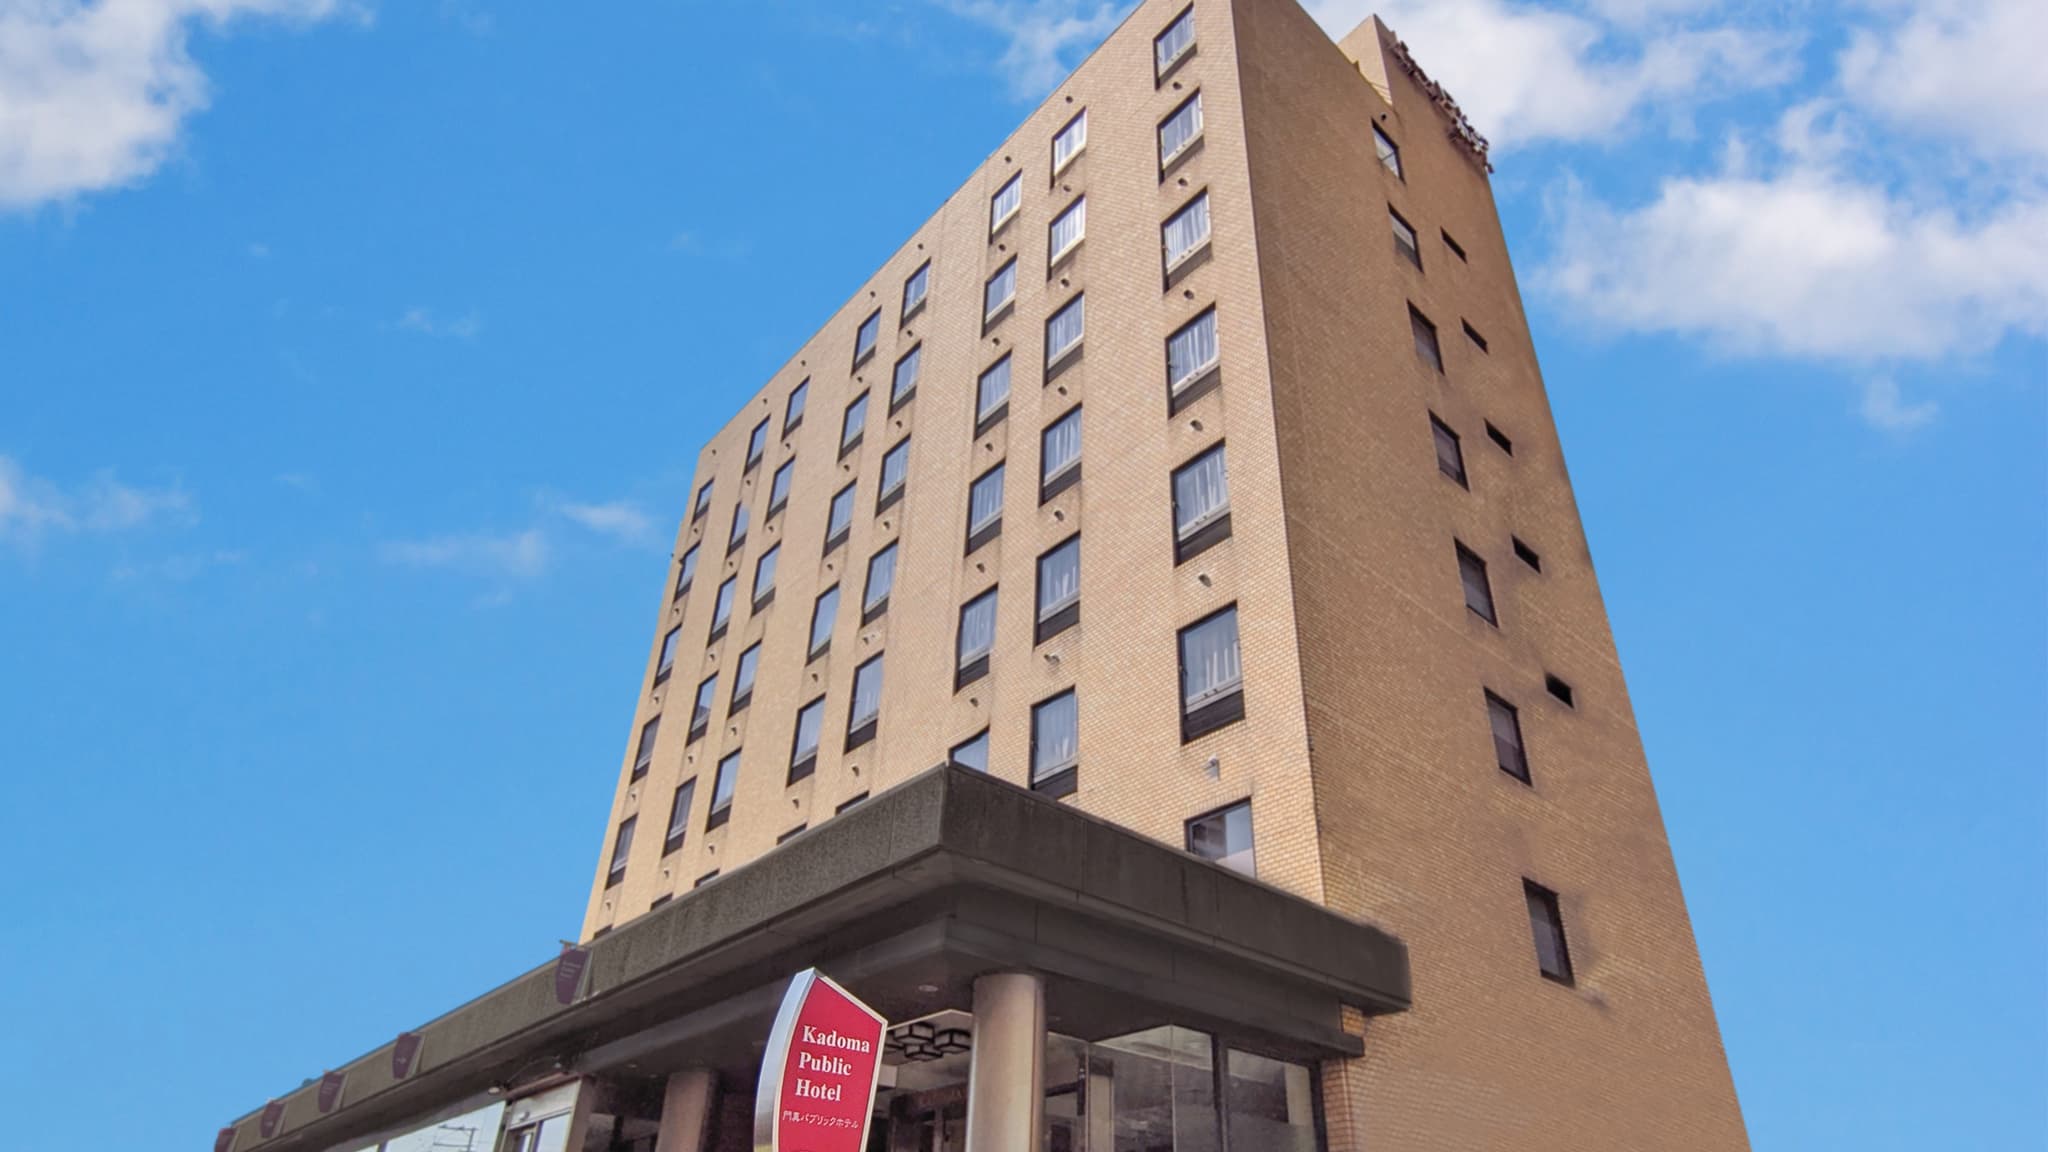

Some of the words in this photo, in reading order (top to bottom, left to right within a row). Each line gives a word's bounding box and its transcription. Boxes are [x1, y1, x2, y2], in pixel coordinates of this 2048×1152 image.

[802, 1025, 871, 1053] Kadoma
[799, 1051, 852, 1076] Public
[795, 1078, 842, 1102] Hotel
